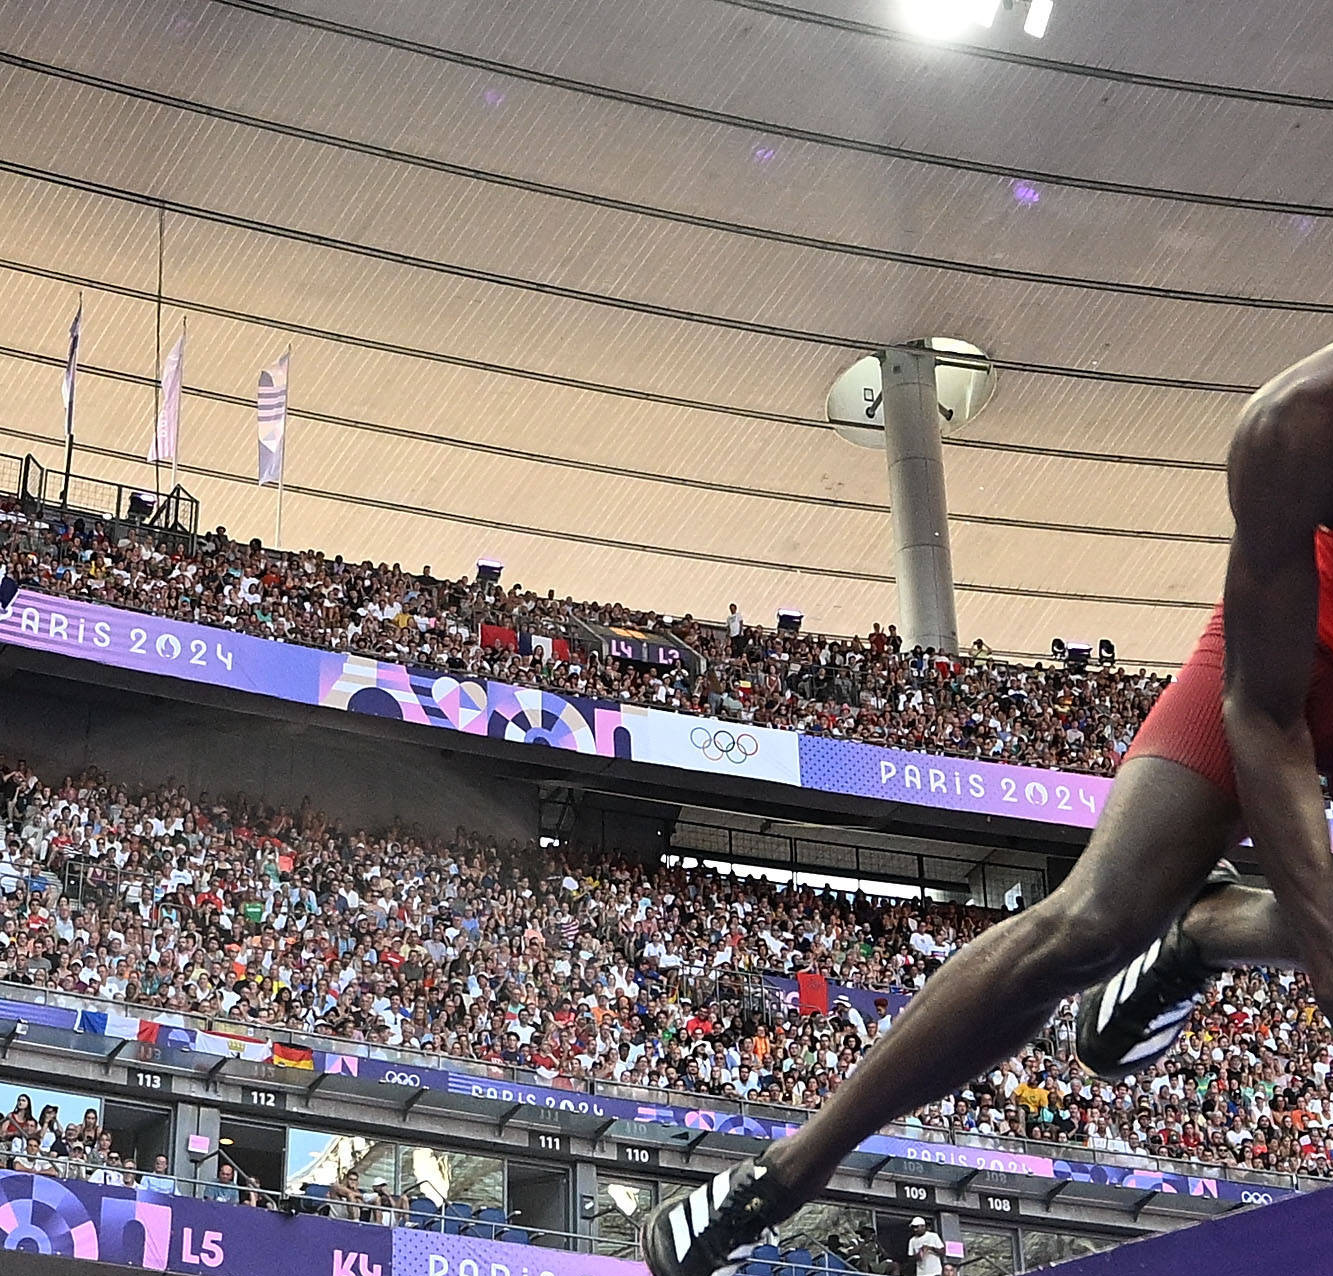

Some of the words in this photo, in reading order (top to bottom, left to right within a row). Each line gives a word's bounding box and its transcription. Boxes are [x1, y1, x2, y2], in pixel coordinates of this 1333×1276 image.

[129, 628, 234, 671] 2024
[1000, 778, 1096, 813] 2024
[137, 1073, 161, 1089] 113
[251, 1091, 275, 1107] 112
[539, 1135, 561, 1150] 111
[626, 1148, 649, 1163] 110
[904, 1186, 927, 1201] 109
[988, 1197, 1011, 1212] 108
[181, 1227, 224, 1268] L5
